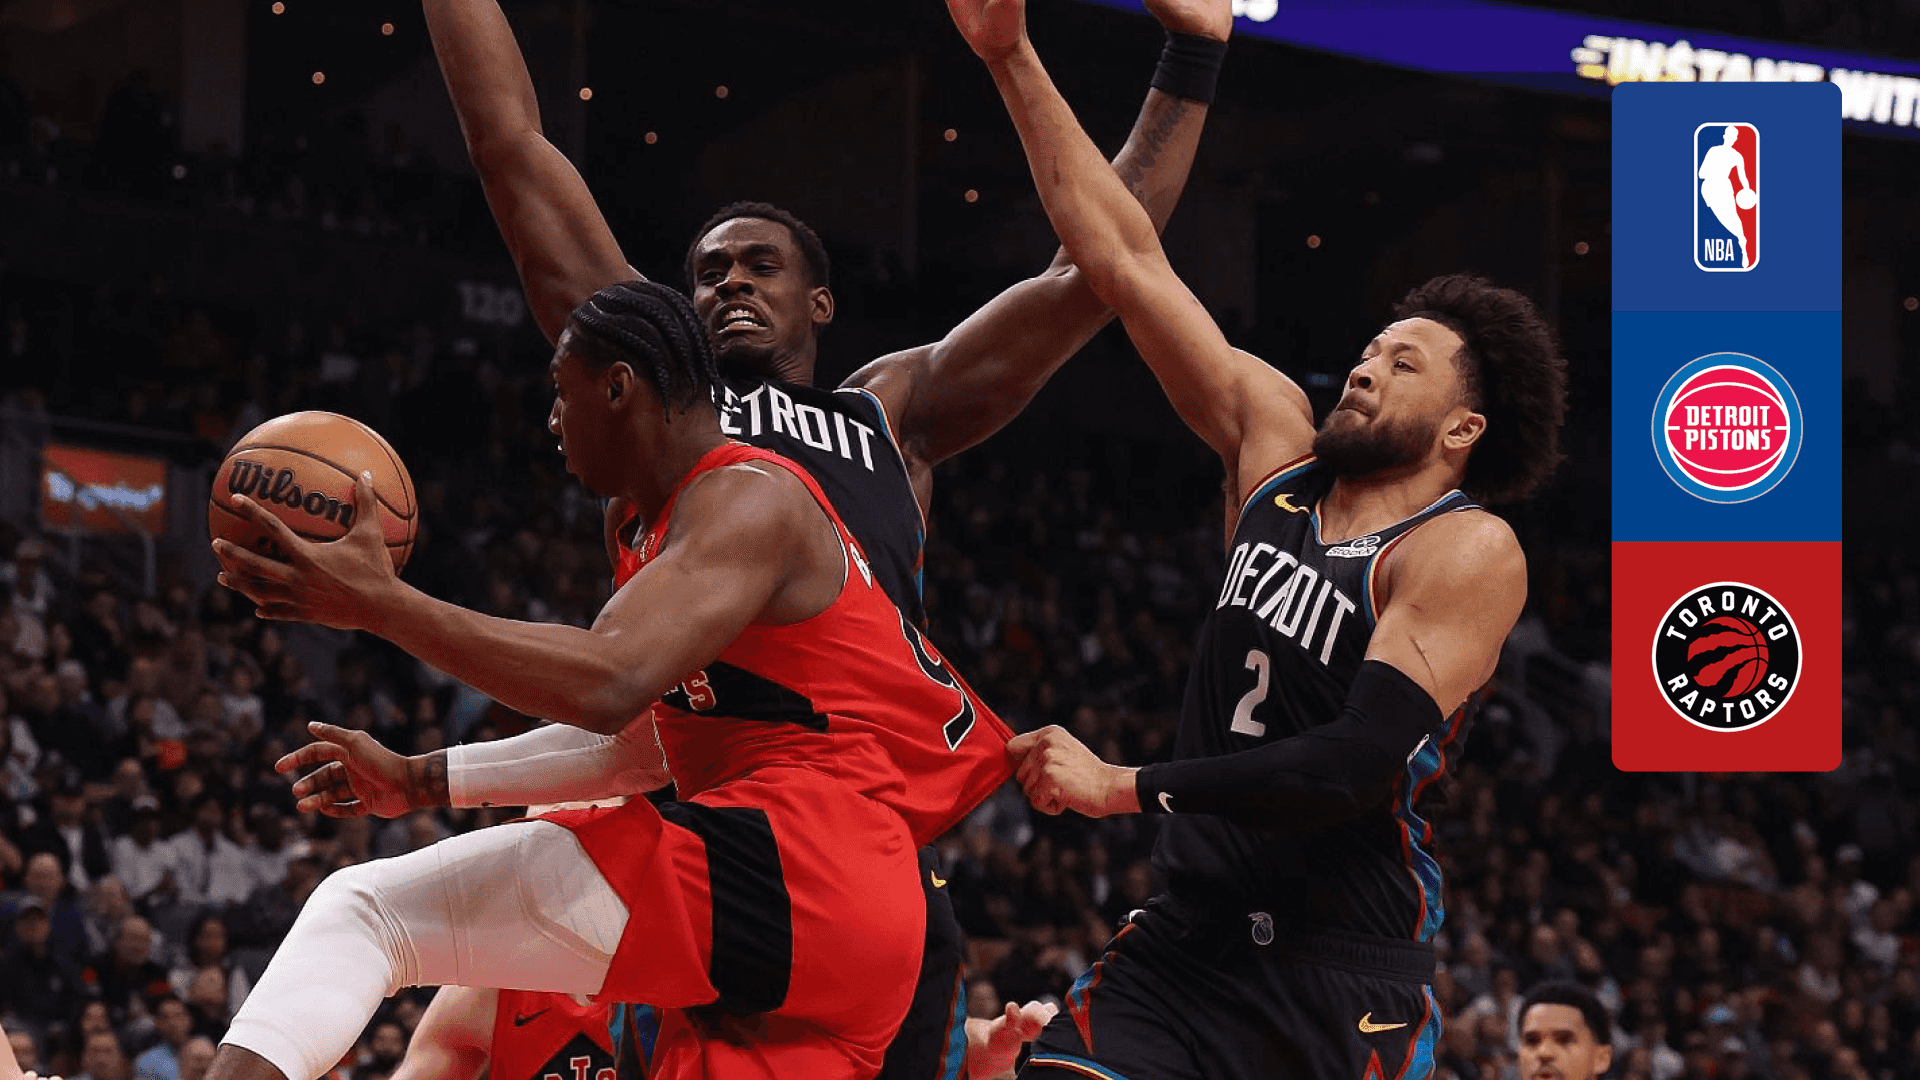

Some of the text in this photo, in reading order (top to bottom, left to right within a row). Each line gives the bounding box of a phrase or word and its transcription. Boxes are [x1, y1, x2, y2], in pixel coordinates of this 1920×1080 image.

[1829, 67, 1920, 128] WIT
[710, 384, 875, 472] ETROIT
[228, 461, 354, 528] Wilson
[1216, 542, 1356, 666] DETROIT
[1230, 649, 1271, 738] 2
